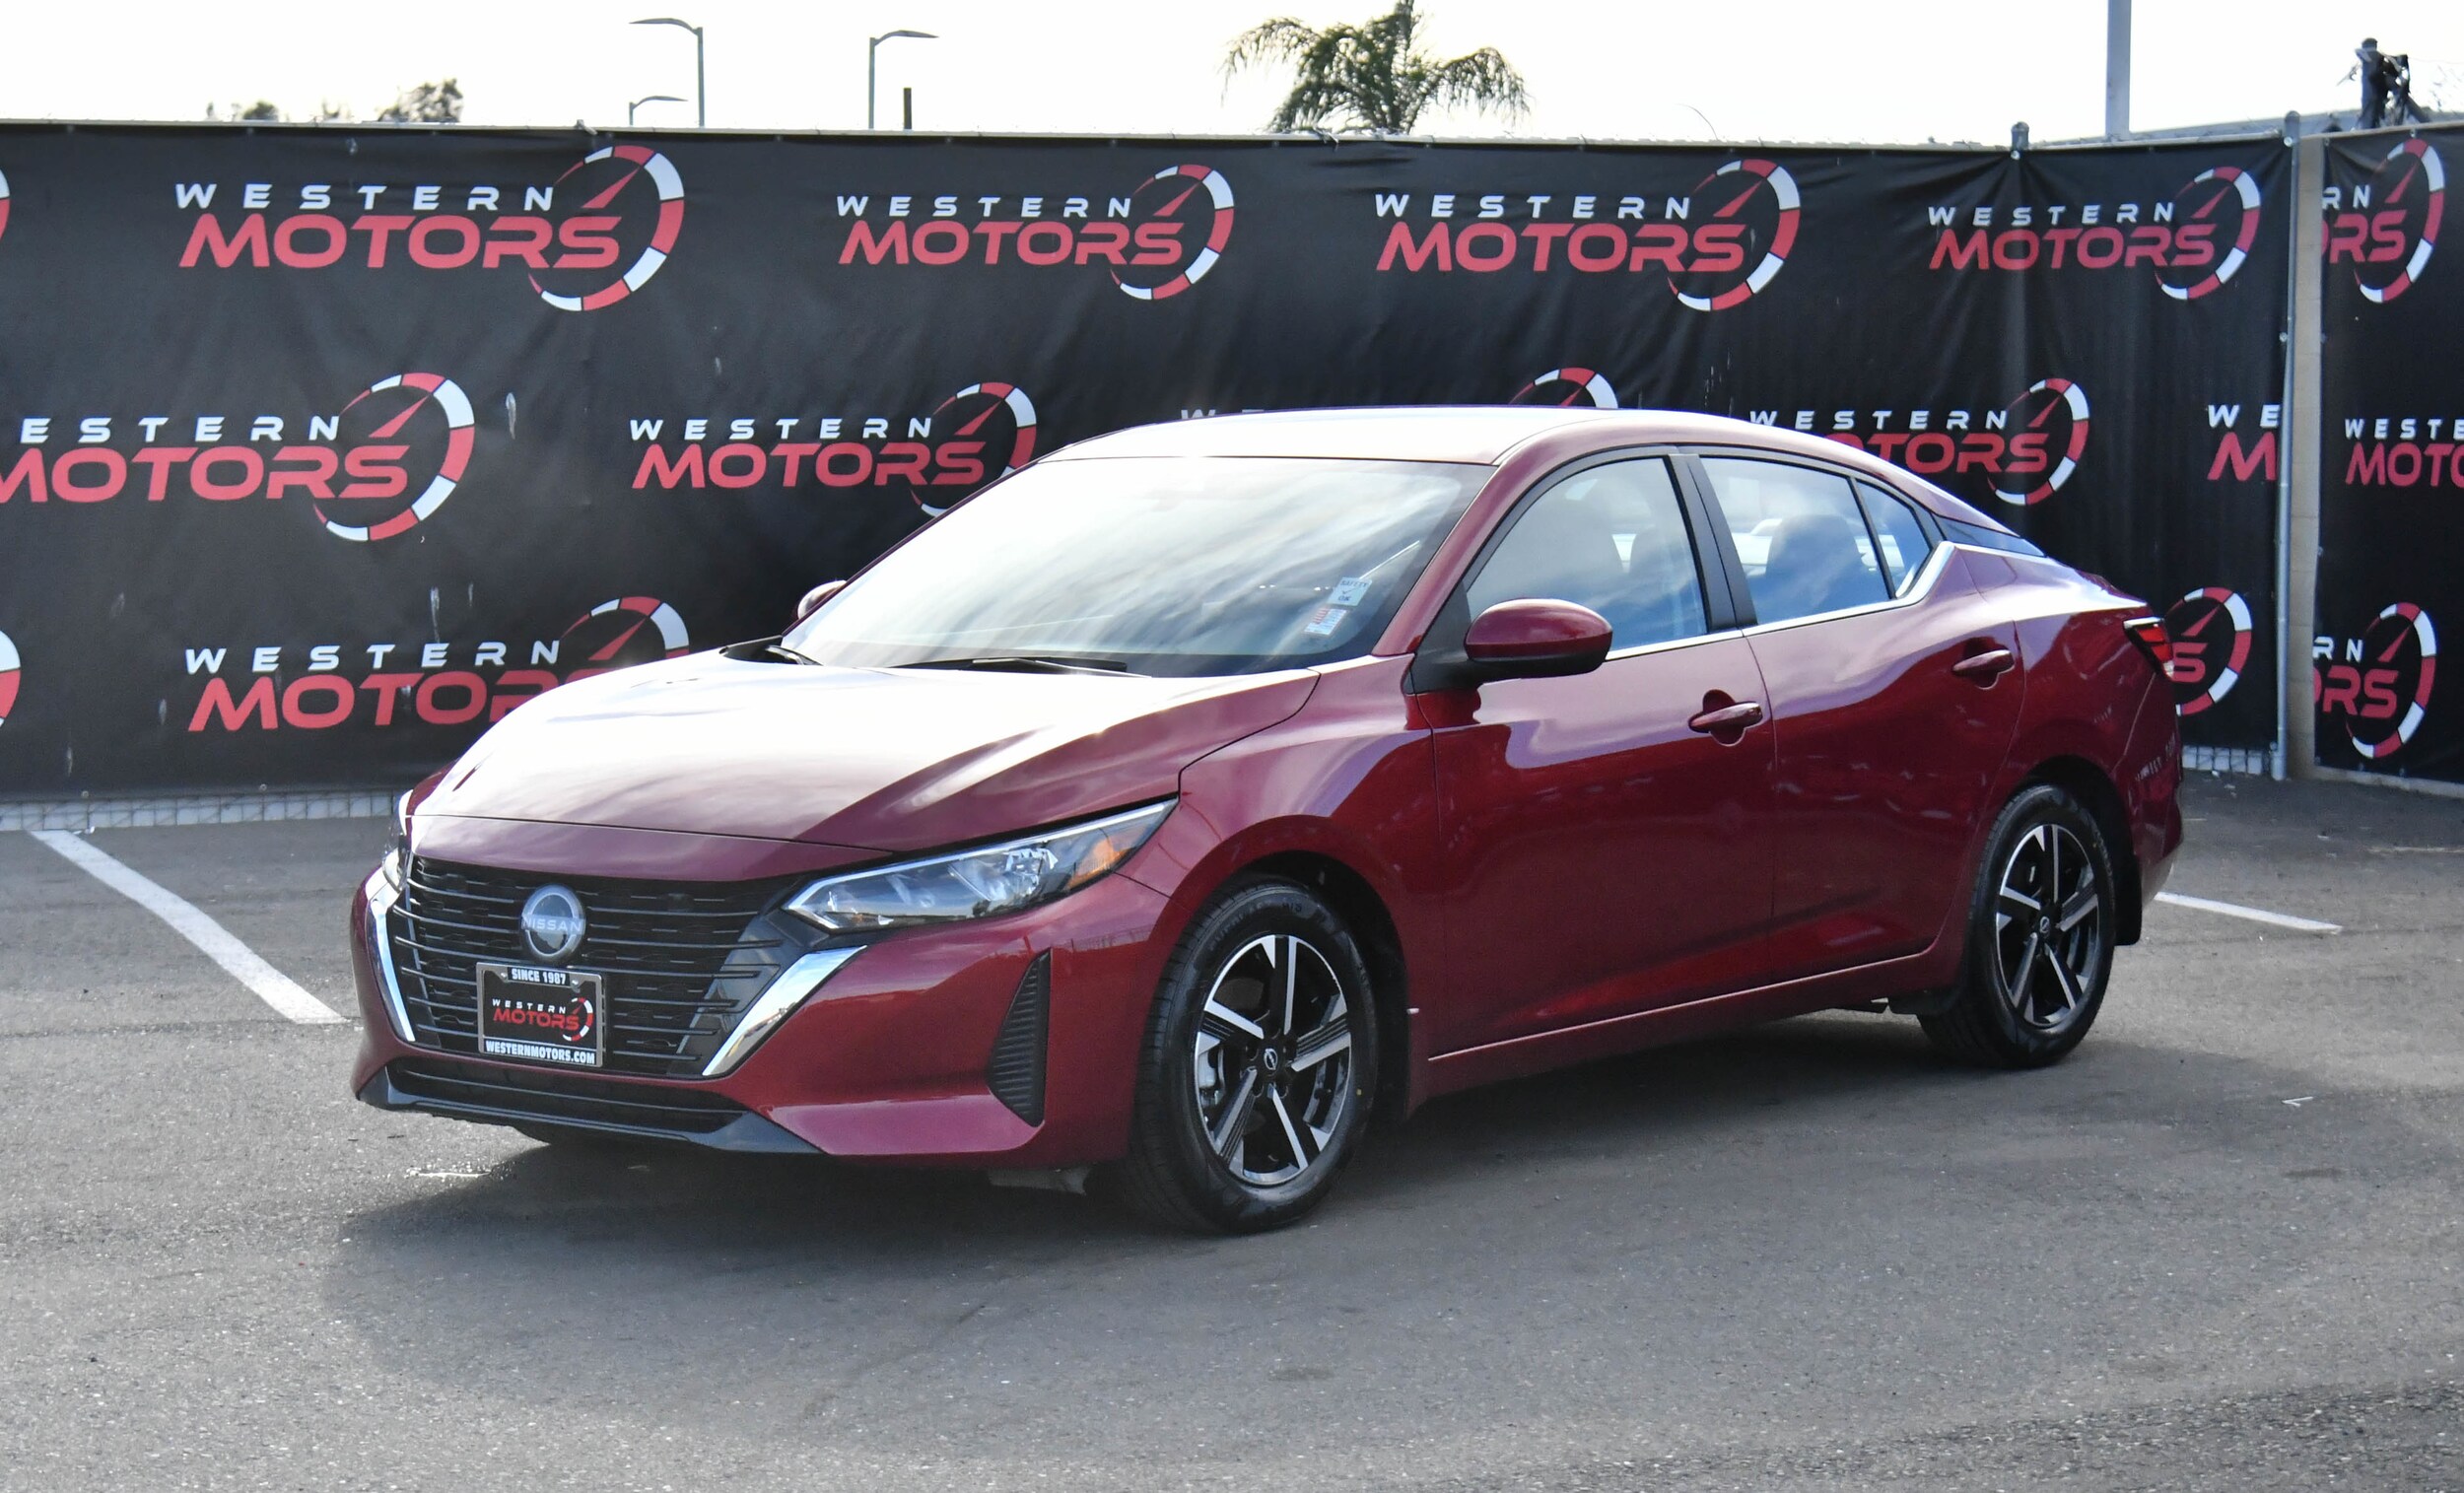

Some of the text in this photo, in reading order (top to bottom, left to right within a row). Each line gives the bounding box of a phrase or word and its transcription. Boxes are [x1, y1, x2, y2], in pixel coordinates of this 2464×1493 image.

[175, 183, 554, 212] WESTERN
[837, 195, 1131, 219] WESTERN
[1375, 194, 1689, 220] WESTERN
[1928, 202, 2174, 228] WESTERN
[178, 213, 622, 269] MOTORS
[838, 220, 1185, 266] MOTORS
[1376, 222, 1746, 273] MOTORS
[1929, 224, 2217, 271] MOTORS
[630, 417, 931, 441] WESTERN
[1749, 410, 2007, 431] WESTERN
[632, 441, 986, 490] MOTORS
[1823, 432, 2049, 473] TORS
[185, 640, 560, 674] WESTERN
[187, 667, 614, 732] MOTOR
[2313, 664, 2399, 718] RS
[522, 916, 582, 932] NISSAN
[512, 968, 567, 984] SINCE 1987
[492, 998, 567, 1014] WESTERN
[493, 1007, 581, 1031] MOTORS
[486, 1041, 595, 1064] WESTERNMOTORS.COM
